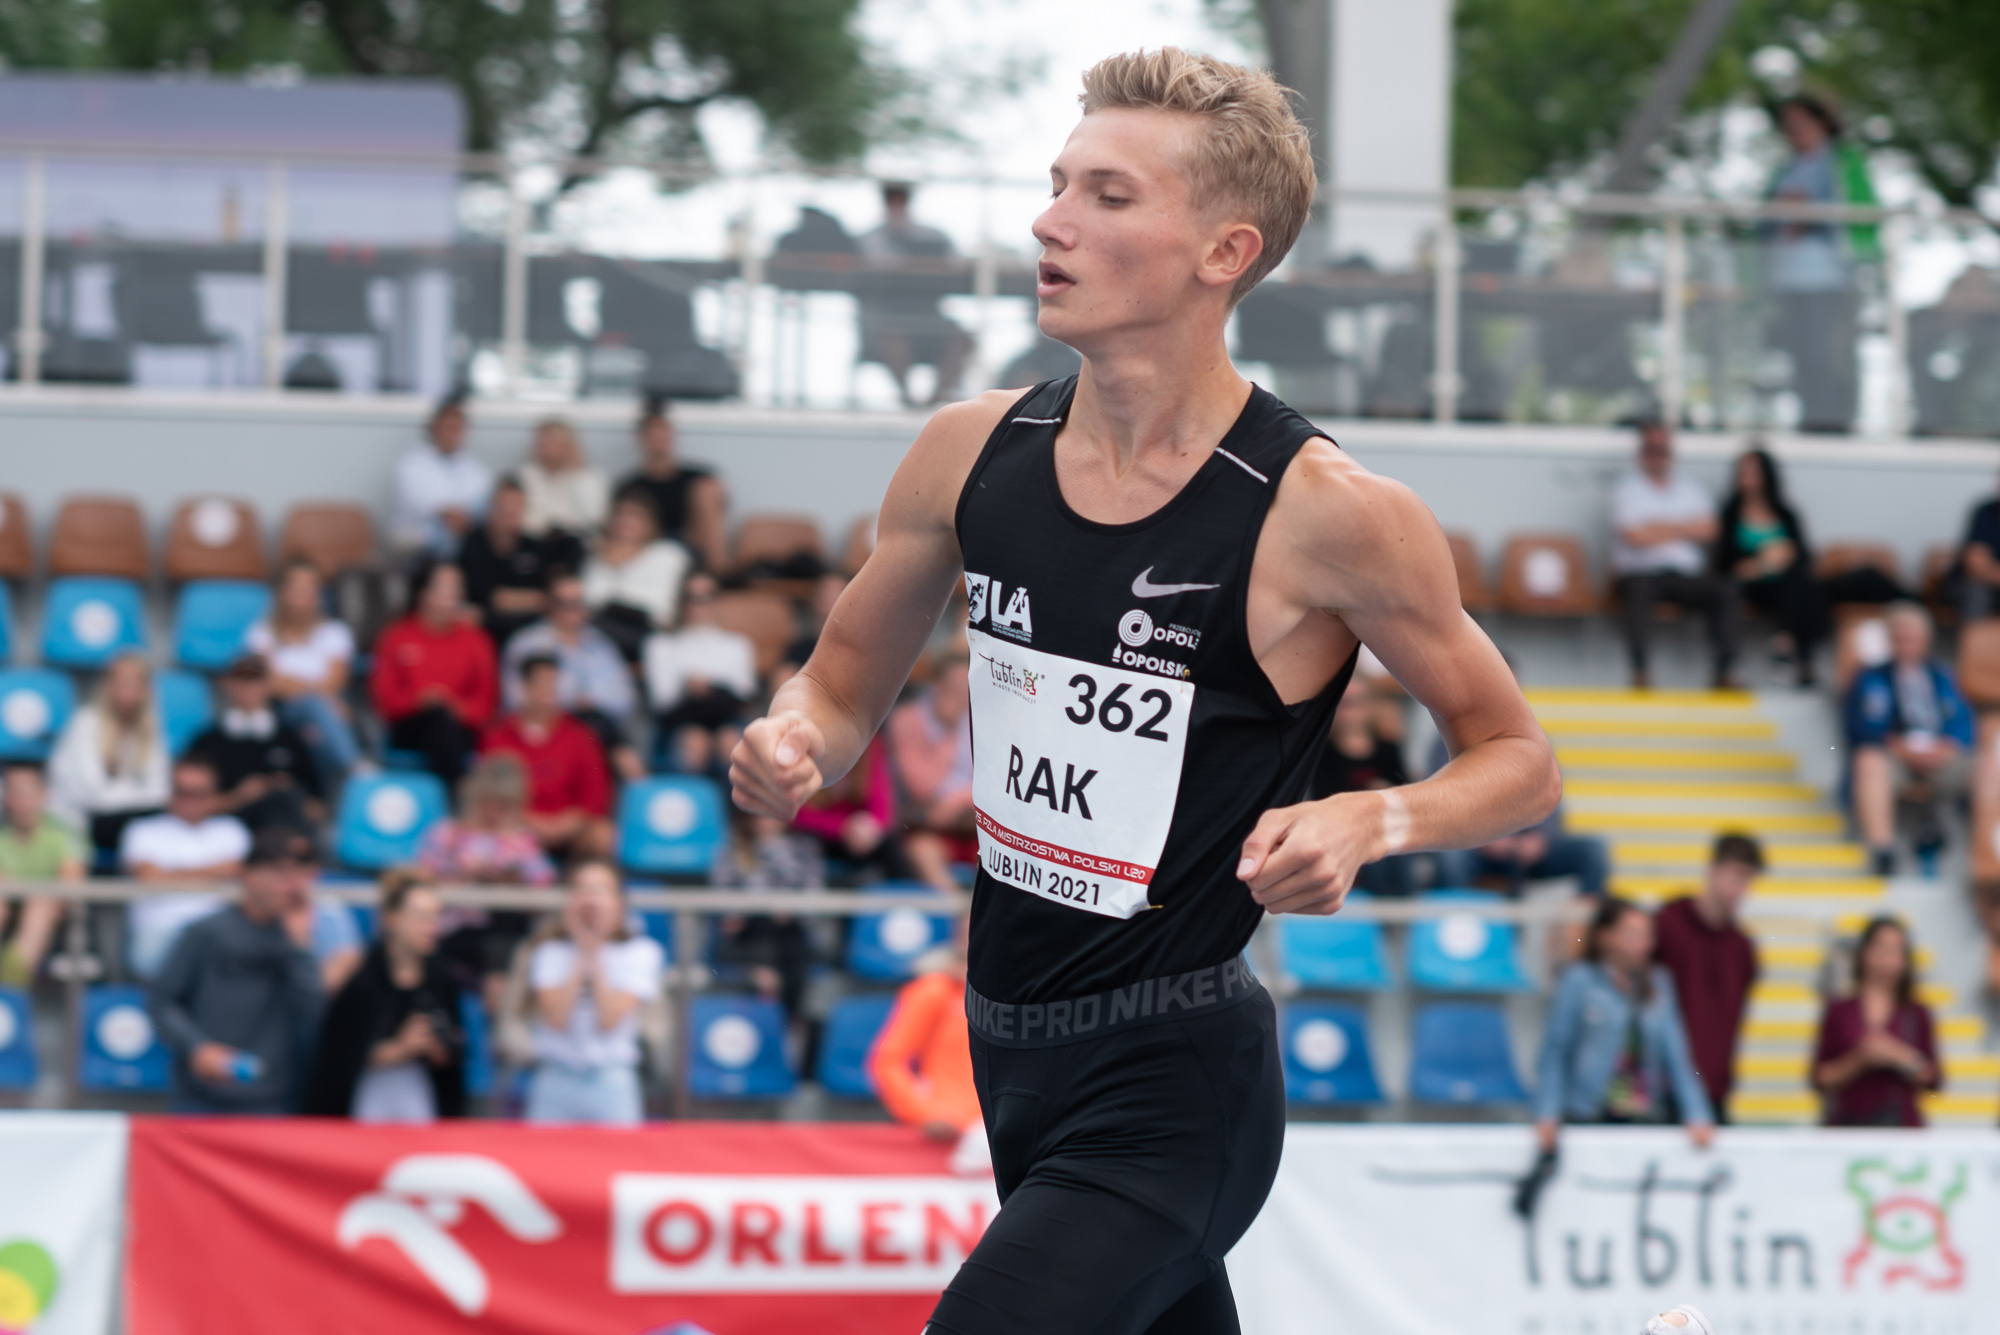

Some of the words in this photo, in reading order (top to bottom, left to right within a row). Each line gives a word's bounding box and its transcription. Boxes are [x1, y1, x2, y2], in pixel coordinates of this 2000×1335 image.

[1065, 673, 1173, 742] 362
[1005, 743, 1099, 821] RAK
[988, 845, 1042, 889] LUBLIN
[1047, 872, 1100, 906] 2021
[997, 828, 1071, 863] MISTRZOSTWA
[1072, 854, 1121, 875] POLSKI
[967, 983, 1015, 1040] NIKE
[1020, 994, 1101, 1040] PRO
[1108, 966, 1218, 1026] NIKE
[1222, 952, 1255, 999] PR
[643, 1201, 987, 1267] ORLEN
